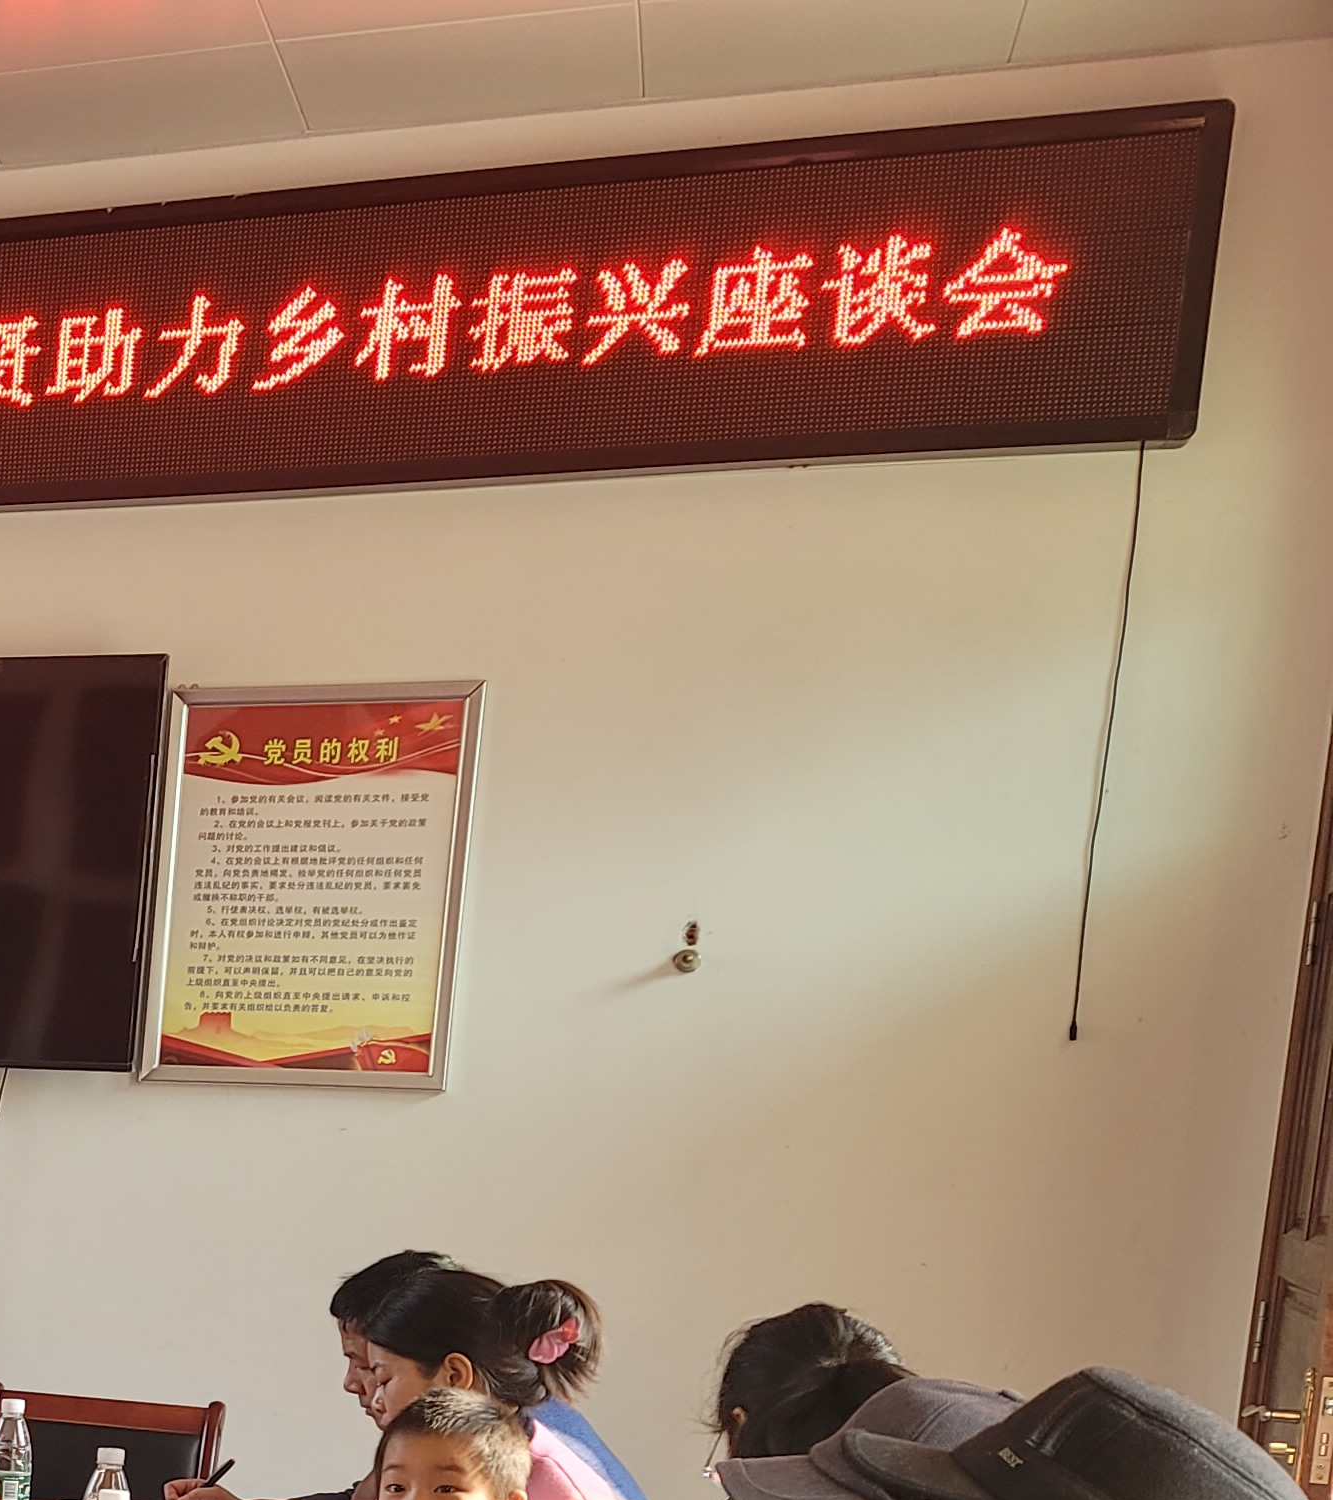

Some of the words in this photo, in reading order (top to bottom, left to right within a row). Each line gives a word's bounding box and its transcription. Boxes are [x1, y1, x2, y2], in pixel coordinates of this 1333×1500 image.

[263, 736, 399, 766] 党员的权利
